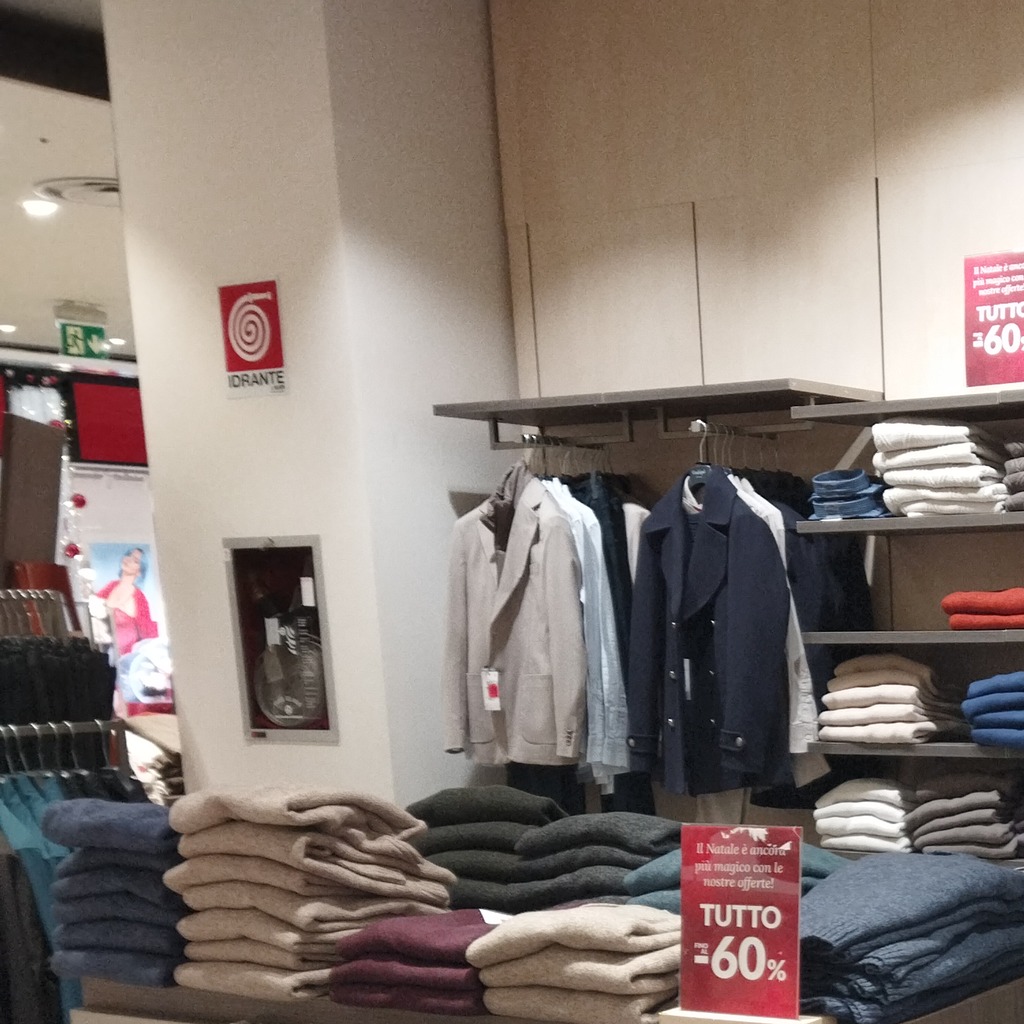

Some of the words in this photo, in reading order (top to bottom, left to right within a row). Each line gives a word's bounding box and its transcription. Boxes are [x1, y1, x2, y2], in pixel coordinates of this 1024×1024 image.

[228, 370, 285, 388] IDRANTE
[696, 843, 704, 854] Il
[706, 843, 739, 855] Natale
[741, 844, 748, 855] è
[750, 846, 786, 856] ancora
[695, 860, 711, 874] più
[714, 861, 750, 875] magico
[753, 864, 772, 873] con
[774, 862, 783, 873] le
[703, 878, 736, 887] nostre
[737, 876, 774, 891] offerte!
[699, 903, 782, 929] TUTTO
